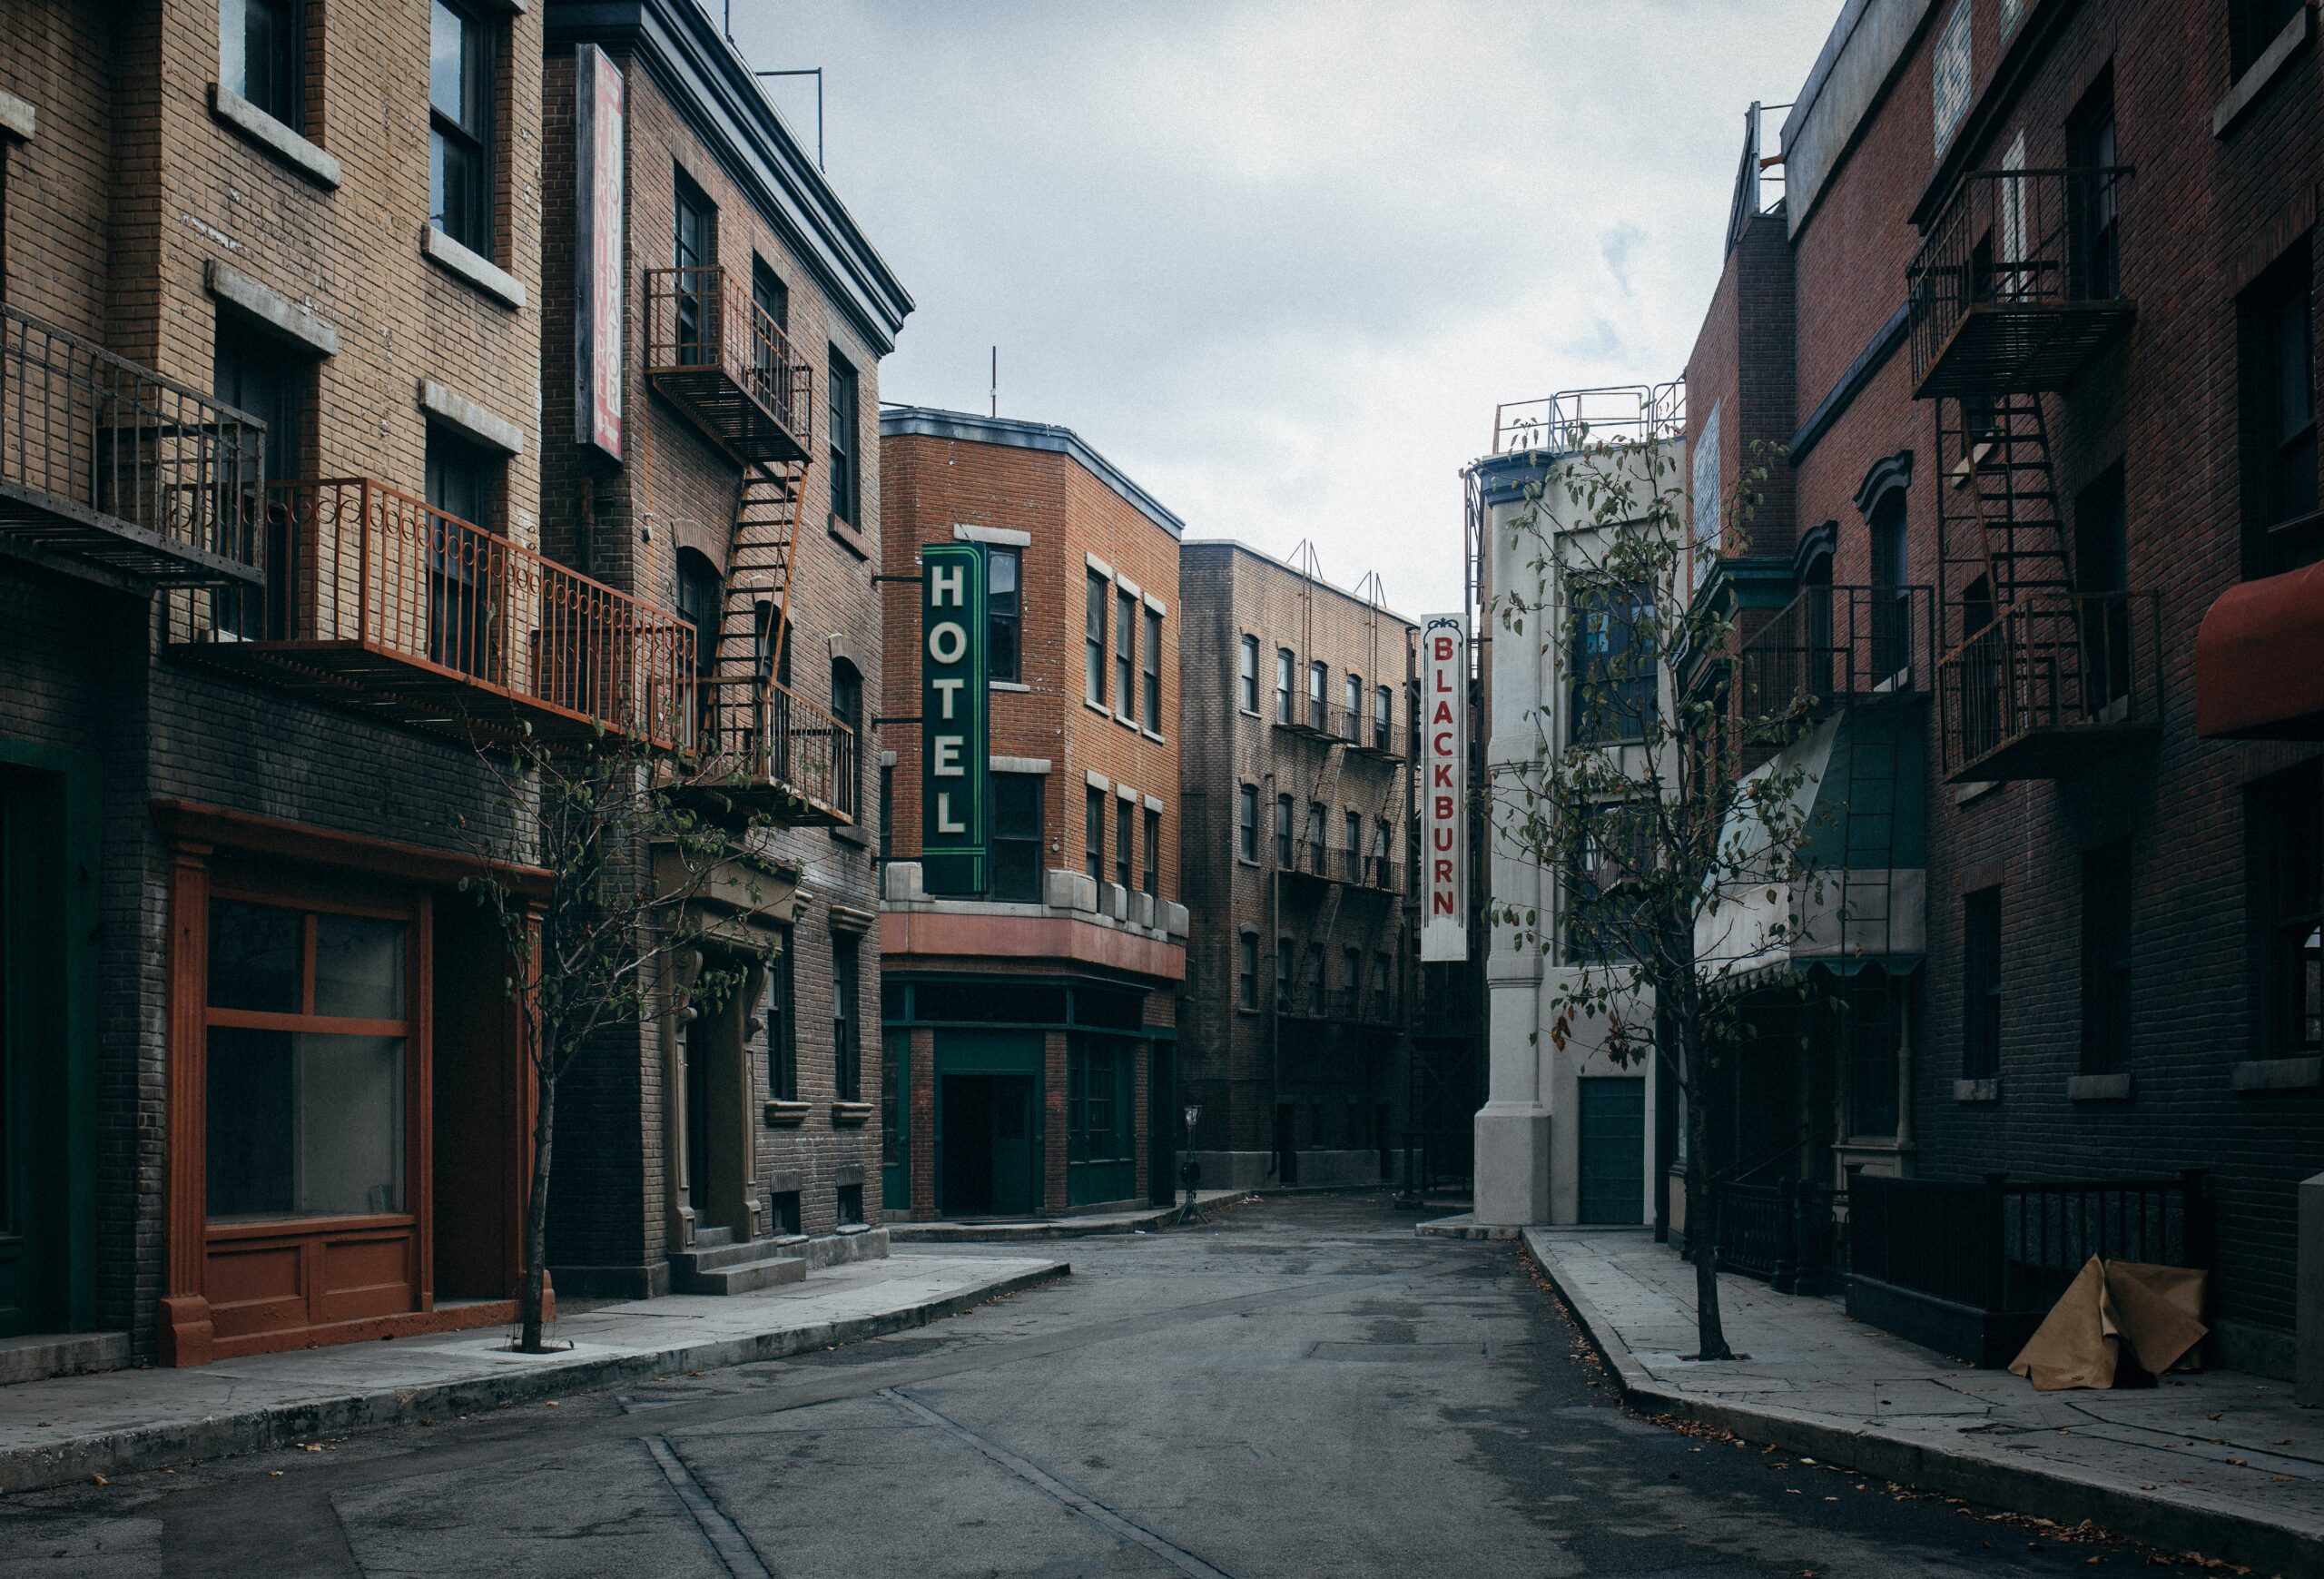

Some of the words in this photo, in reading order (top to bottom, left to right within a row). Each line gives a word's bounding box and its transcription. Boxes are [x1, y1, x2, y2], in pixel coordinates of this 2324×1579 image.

[597, 103, 607, 400] FURNITURE
[608, 119, 619, 412] LIQUIDATOR
[929, 565, 967, 833] HOTEL
[1433, 637, 1454, 915] BLACKBURN
